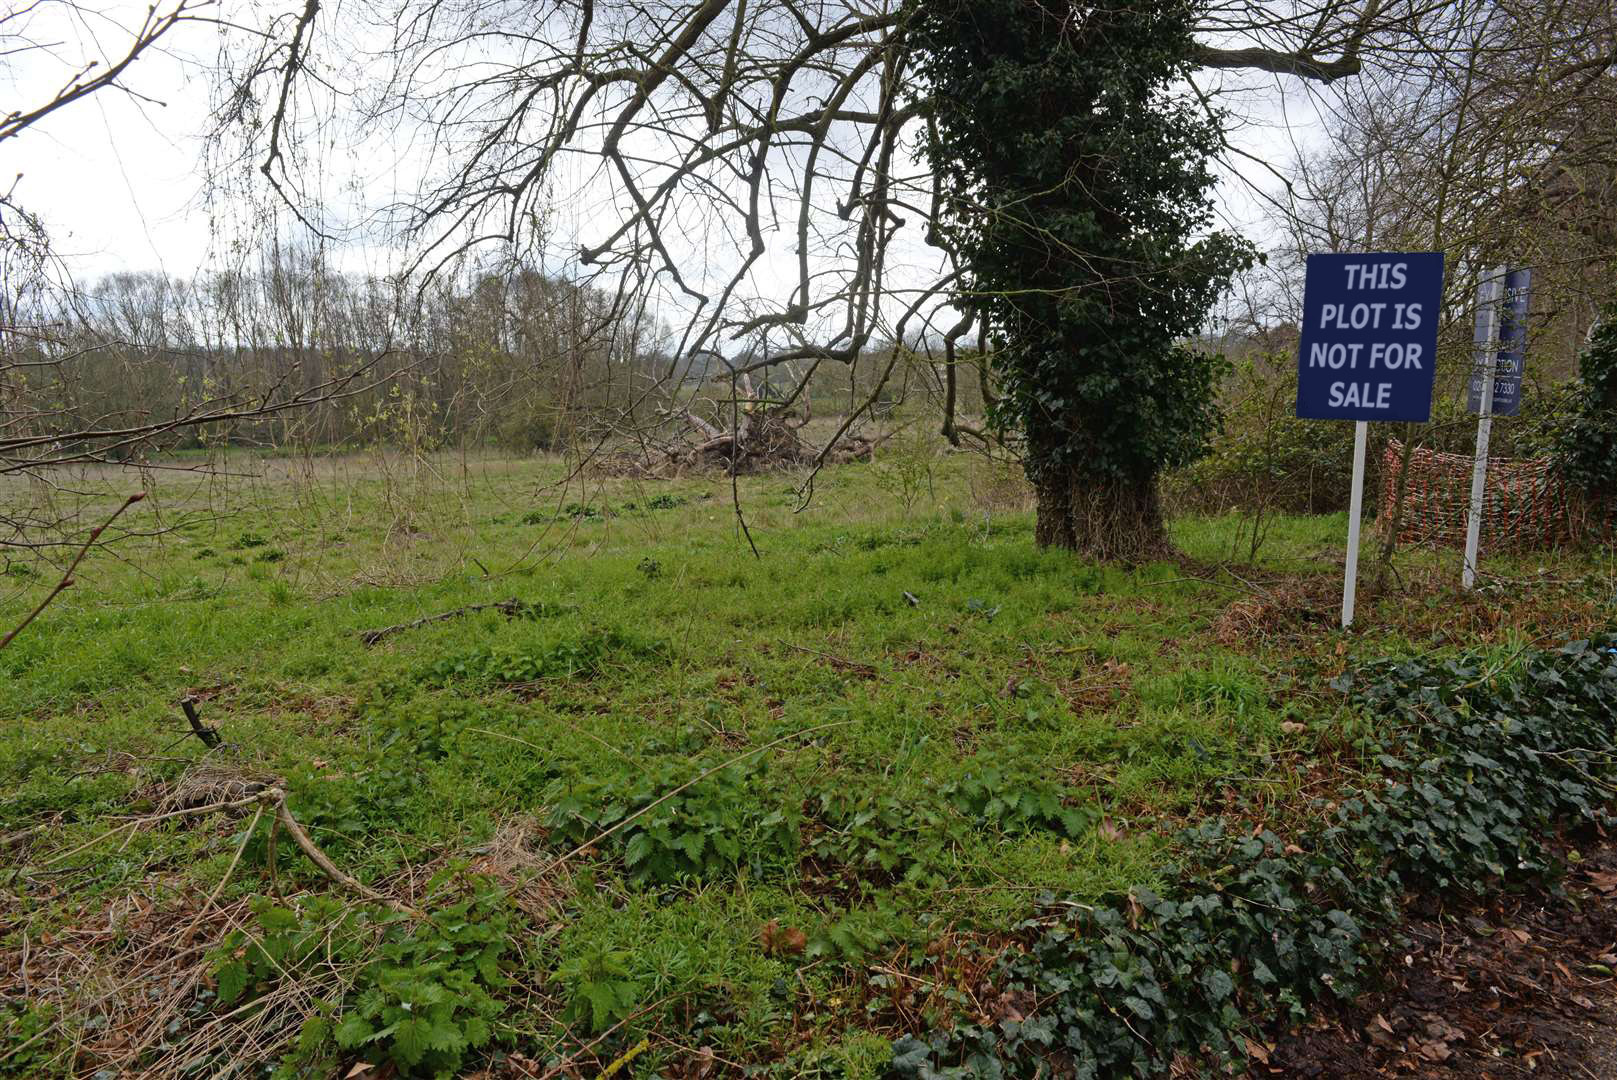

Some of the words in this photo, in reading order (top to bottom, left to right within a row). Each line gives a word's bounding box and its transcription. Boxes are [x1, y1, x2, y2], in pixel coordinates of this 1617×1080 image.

[1345, 263, 1407, 289] THIS
[1320, 303, 1386, 329] PLOT
[1392, 303, 1422, 330] IS
[1309, 343, 1364, 369] NOT
[1369, 343, 1423, 369] FOR
[1328, 381, 1392, 408] SALE
